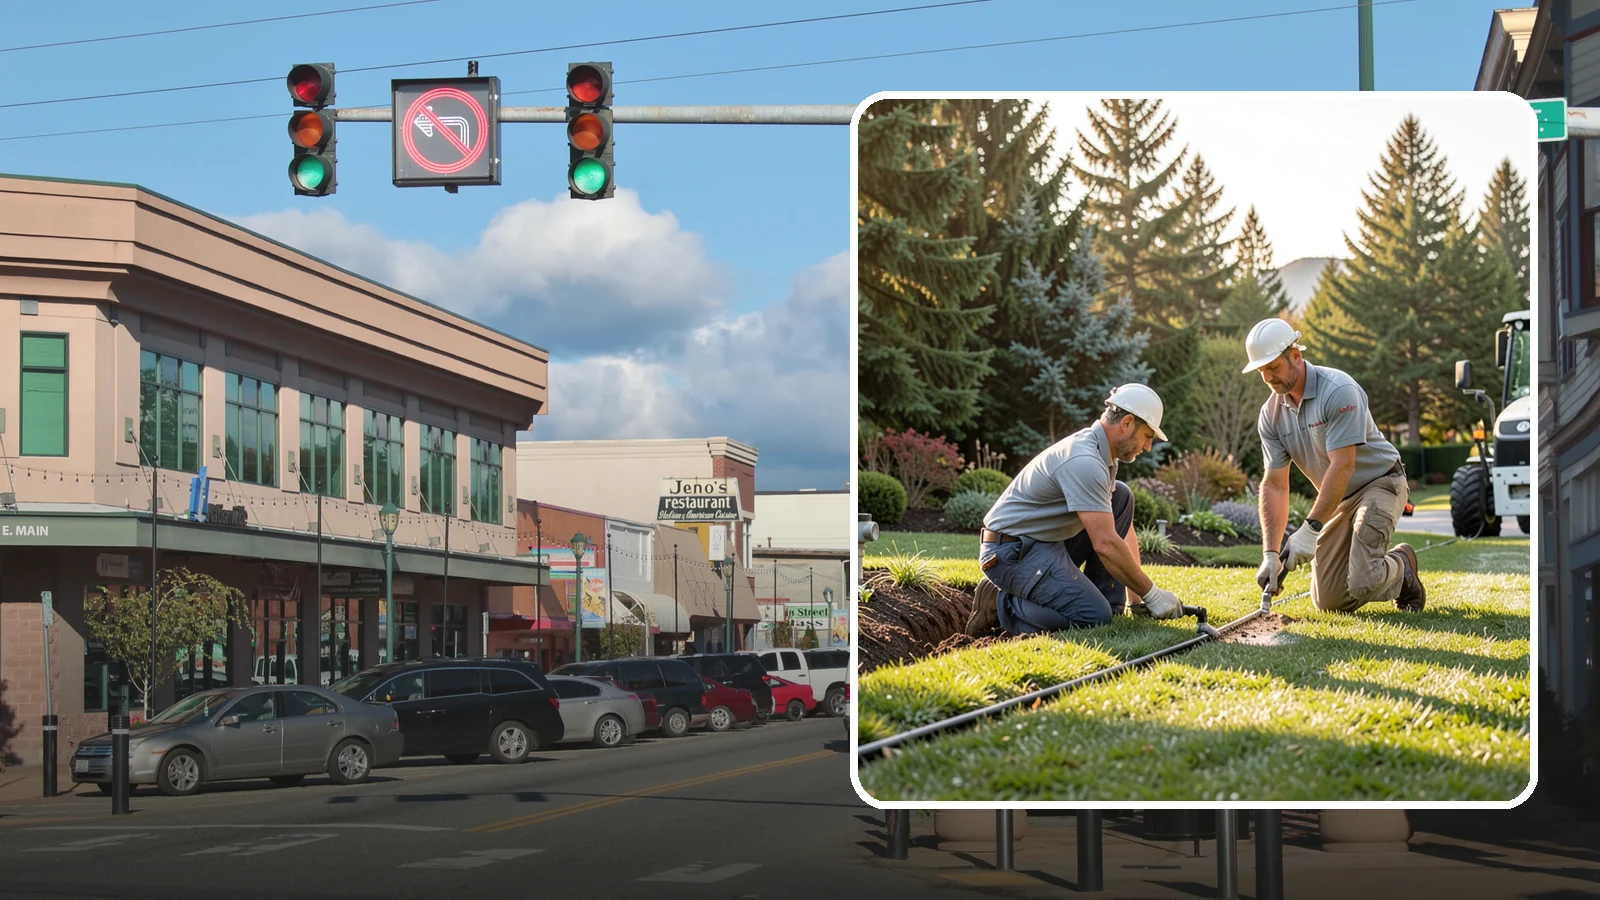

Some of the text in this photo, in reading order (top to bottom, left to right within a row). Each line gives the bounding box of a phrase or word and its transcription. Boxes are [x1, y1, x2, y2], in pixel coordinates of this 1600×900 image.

[670, 480, 727, 494] Jeno's
[665, 496, 731, 509] restaurant
[658, 510, 682, 519] Italian
[686, 510, 714, 519] American
[714, 509, 737, 519] Cuisine
[2, 525, 49, 536] E. MAIN
[797, 607, 828, 617] Street
